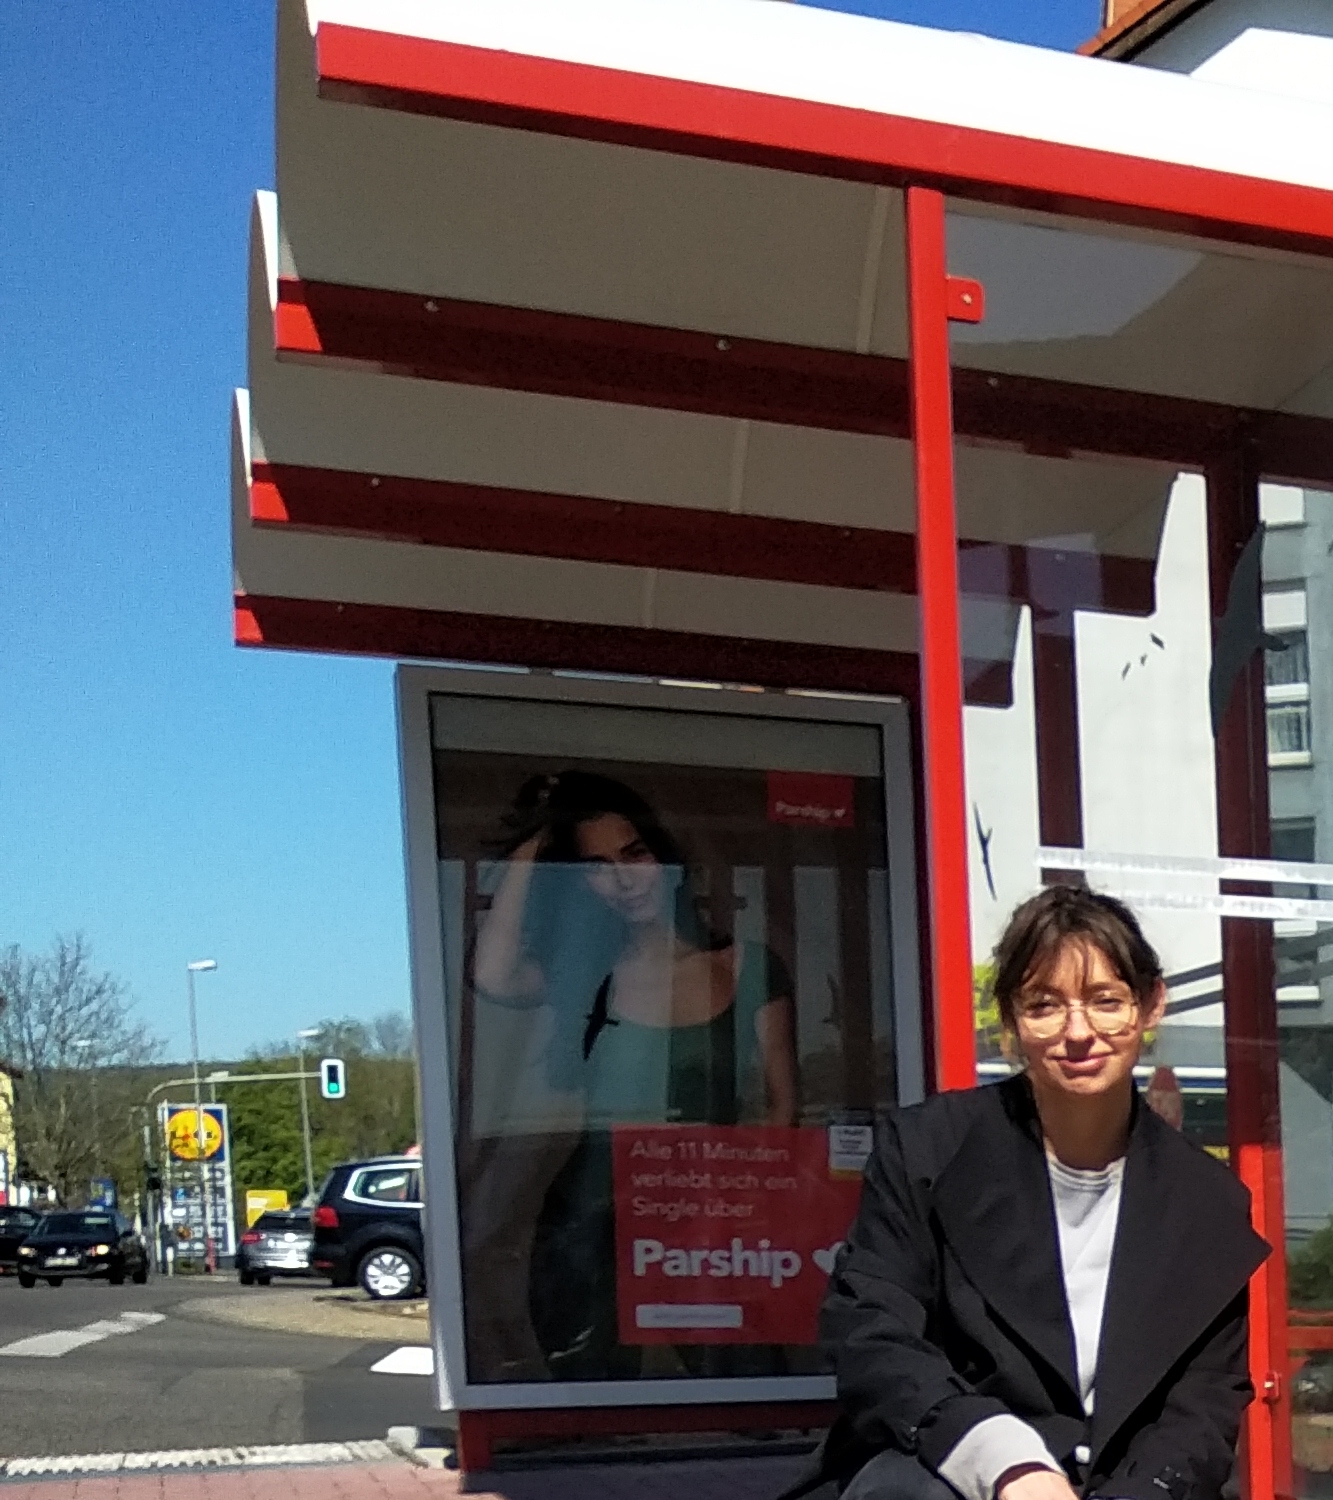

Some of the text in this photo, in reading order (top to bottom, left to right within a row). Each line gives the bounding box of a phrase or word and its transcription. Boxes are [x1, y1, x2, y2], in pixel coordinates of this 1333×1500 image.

[630, 1140, 790, 1162] Alle 11 Minuten
[631, 1169, 797, 1190] verliebt sich ein
[632, 1196, 754, 1222] Single über
[633, 1237, 802, 1288] Parship
